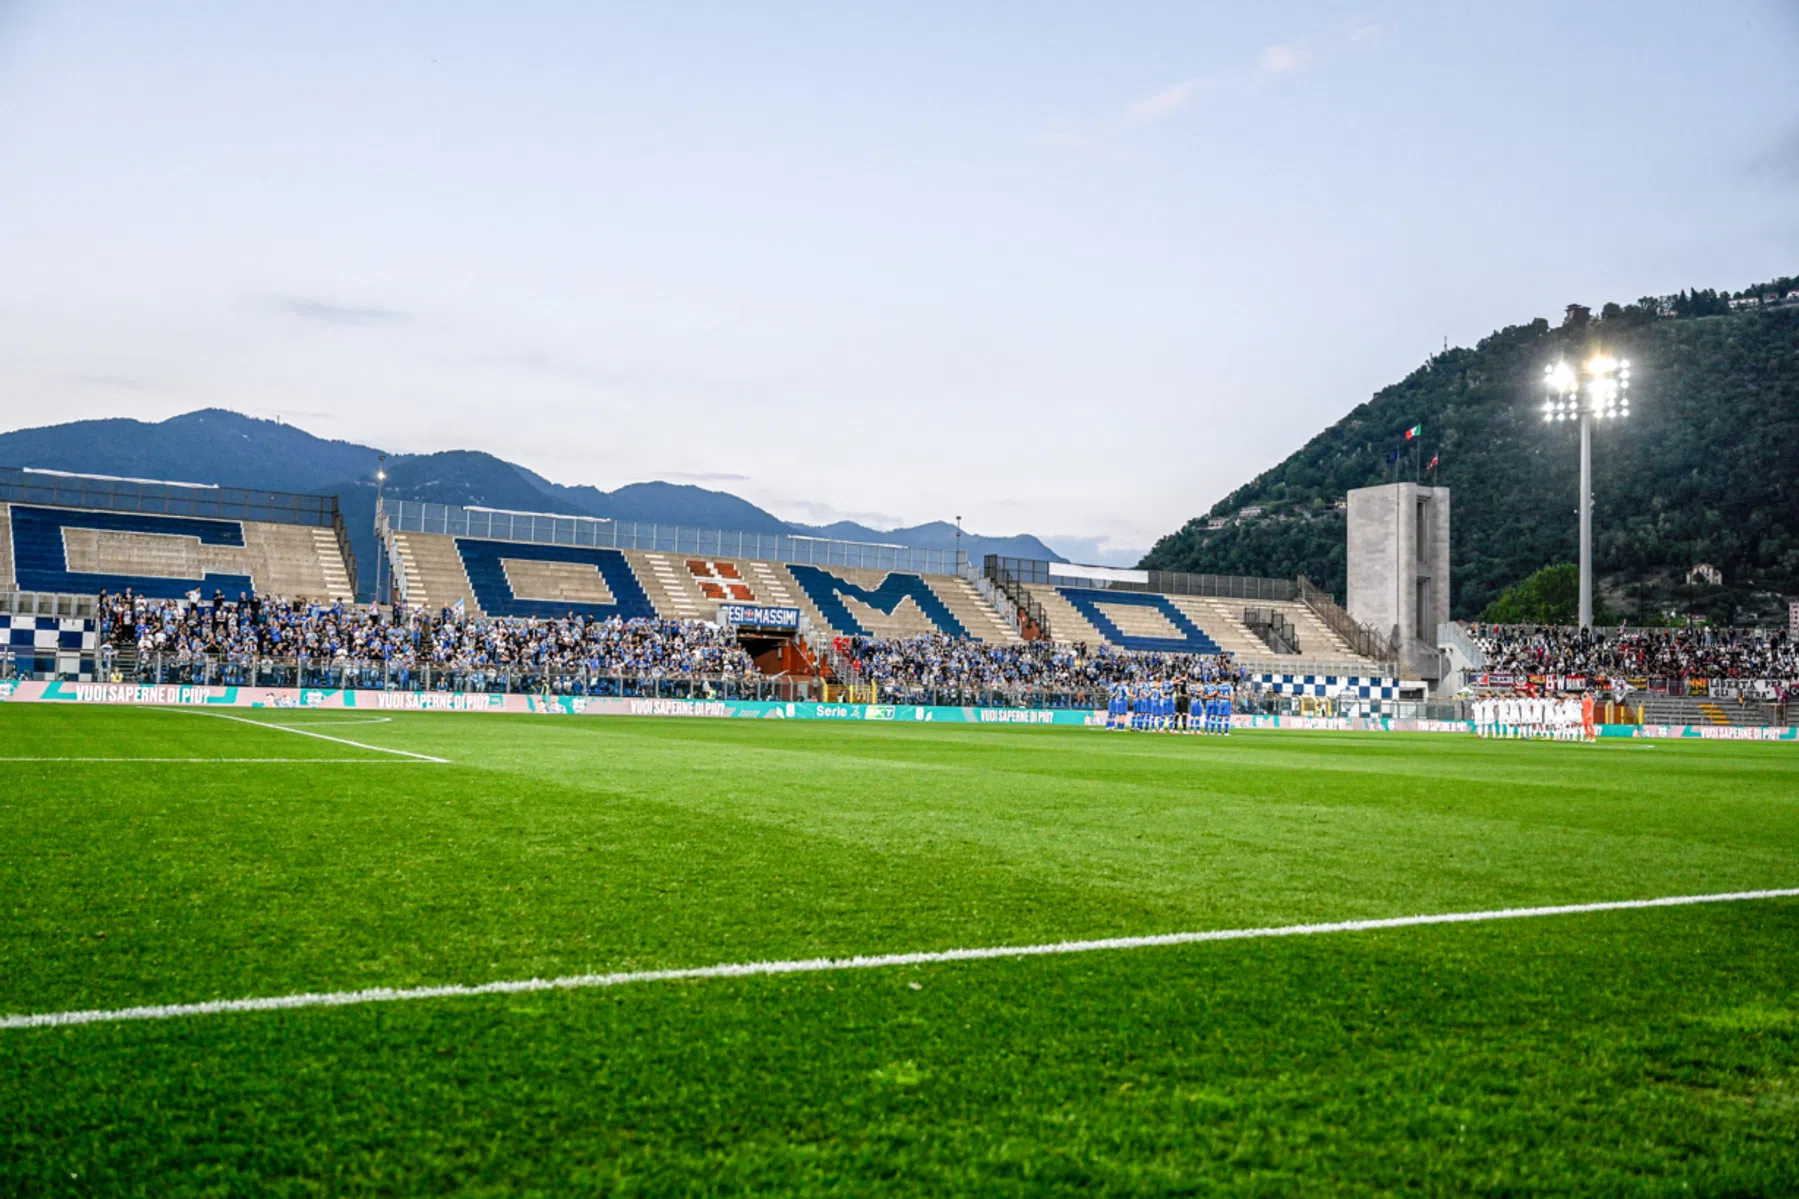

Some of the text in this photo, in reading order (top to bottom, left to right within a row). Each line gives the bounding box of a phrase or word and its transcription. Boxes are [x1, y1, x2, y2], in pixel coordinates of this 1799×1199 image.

[722, 606, 797, 625] ESI MASSIMI
[76, 685, 106, 701] VUOI
[108, 686, 165, 702] SAPERNE
[168, 687, 180, 703] DI
[378, 693, 403, 708] VUOI
[405, 694, 453, 709] SAPERNE
[454, 694, 465, 709] DI
[631, 700, 652, 713] VUOI
[654, 701, 693, 714] SAPERNE
[695, 701, 704, 715] DI
[816, 706, 847, 717] Serie
[981, 710, 998, 721] VUOI
[998, 710, 1029, 723] SAPERNE
[1719, 727, 1753, 738] SAPERNE
